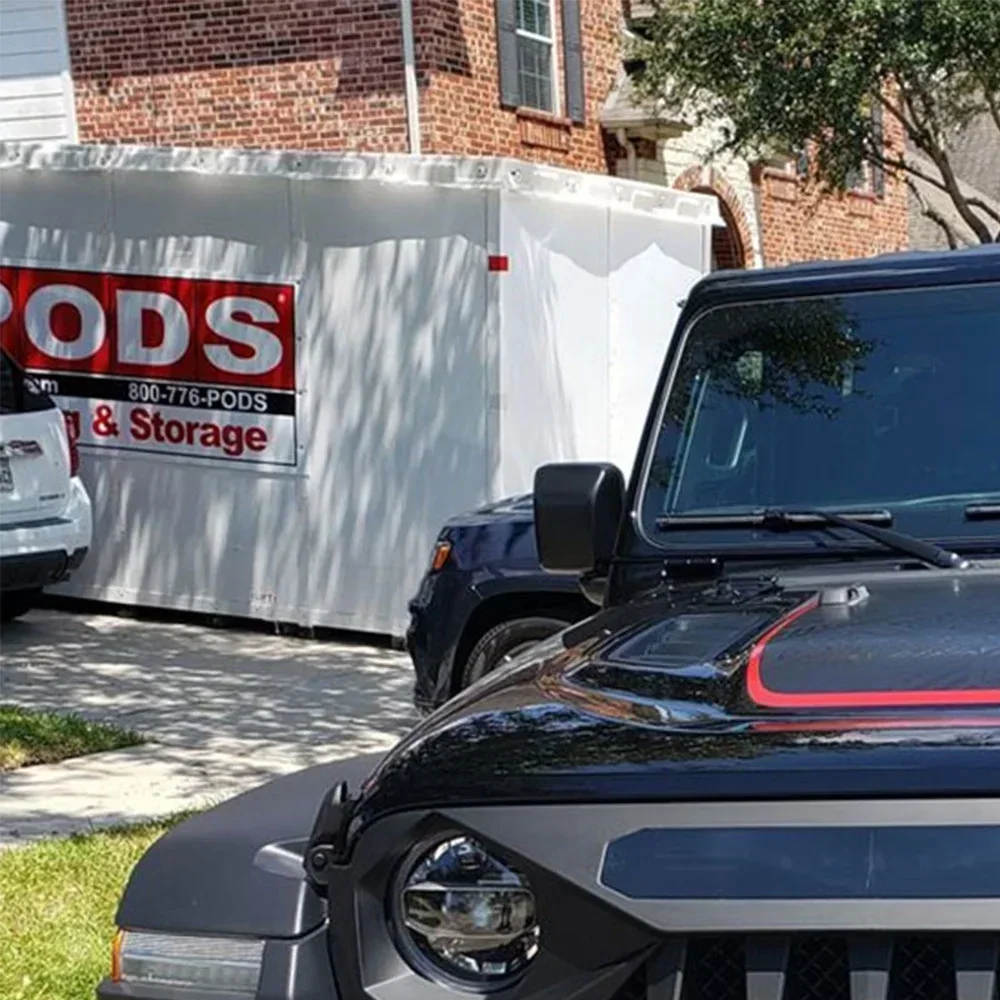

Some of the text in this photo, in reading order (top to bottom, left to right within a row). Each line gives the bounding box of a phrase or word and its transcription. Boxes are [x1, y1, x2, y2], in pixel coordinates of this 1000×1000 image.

[0, 283, 283, 375] ODS
[128, 382, 268, 412] 800-776-PODS
[92, 405, 119, 437] &
[130, 407, 267, 456] Storage
